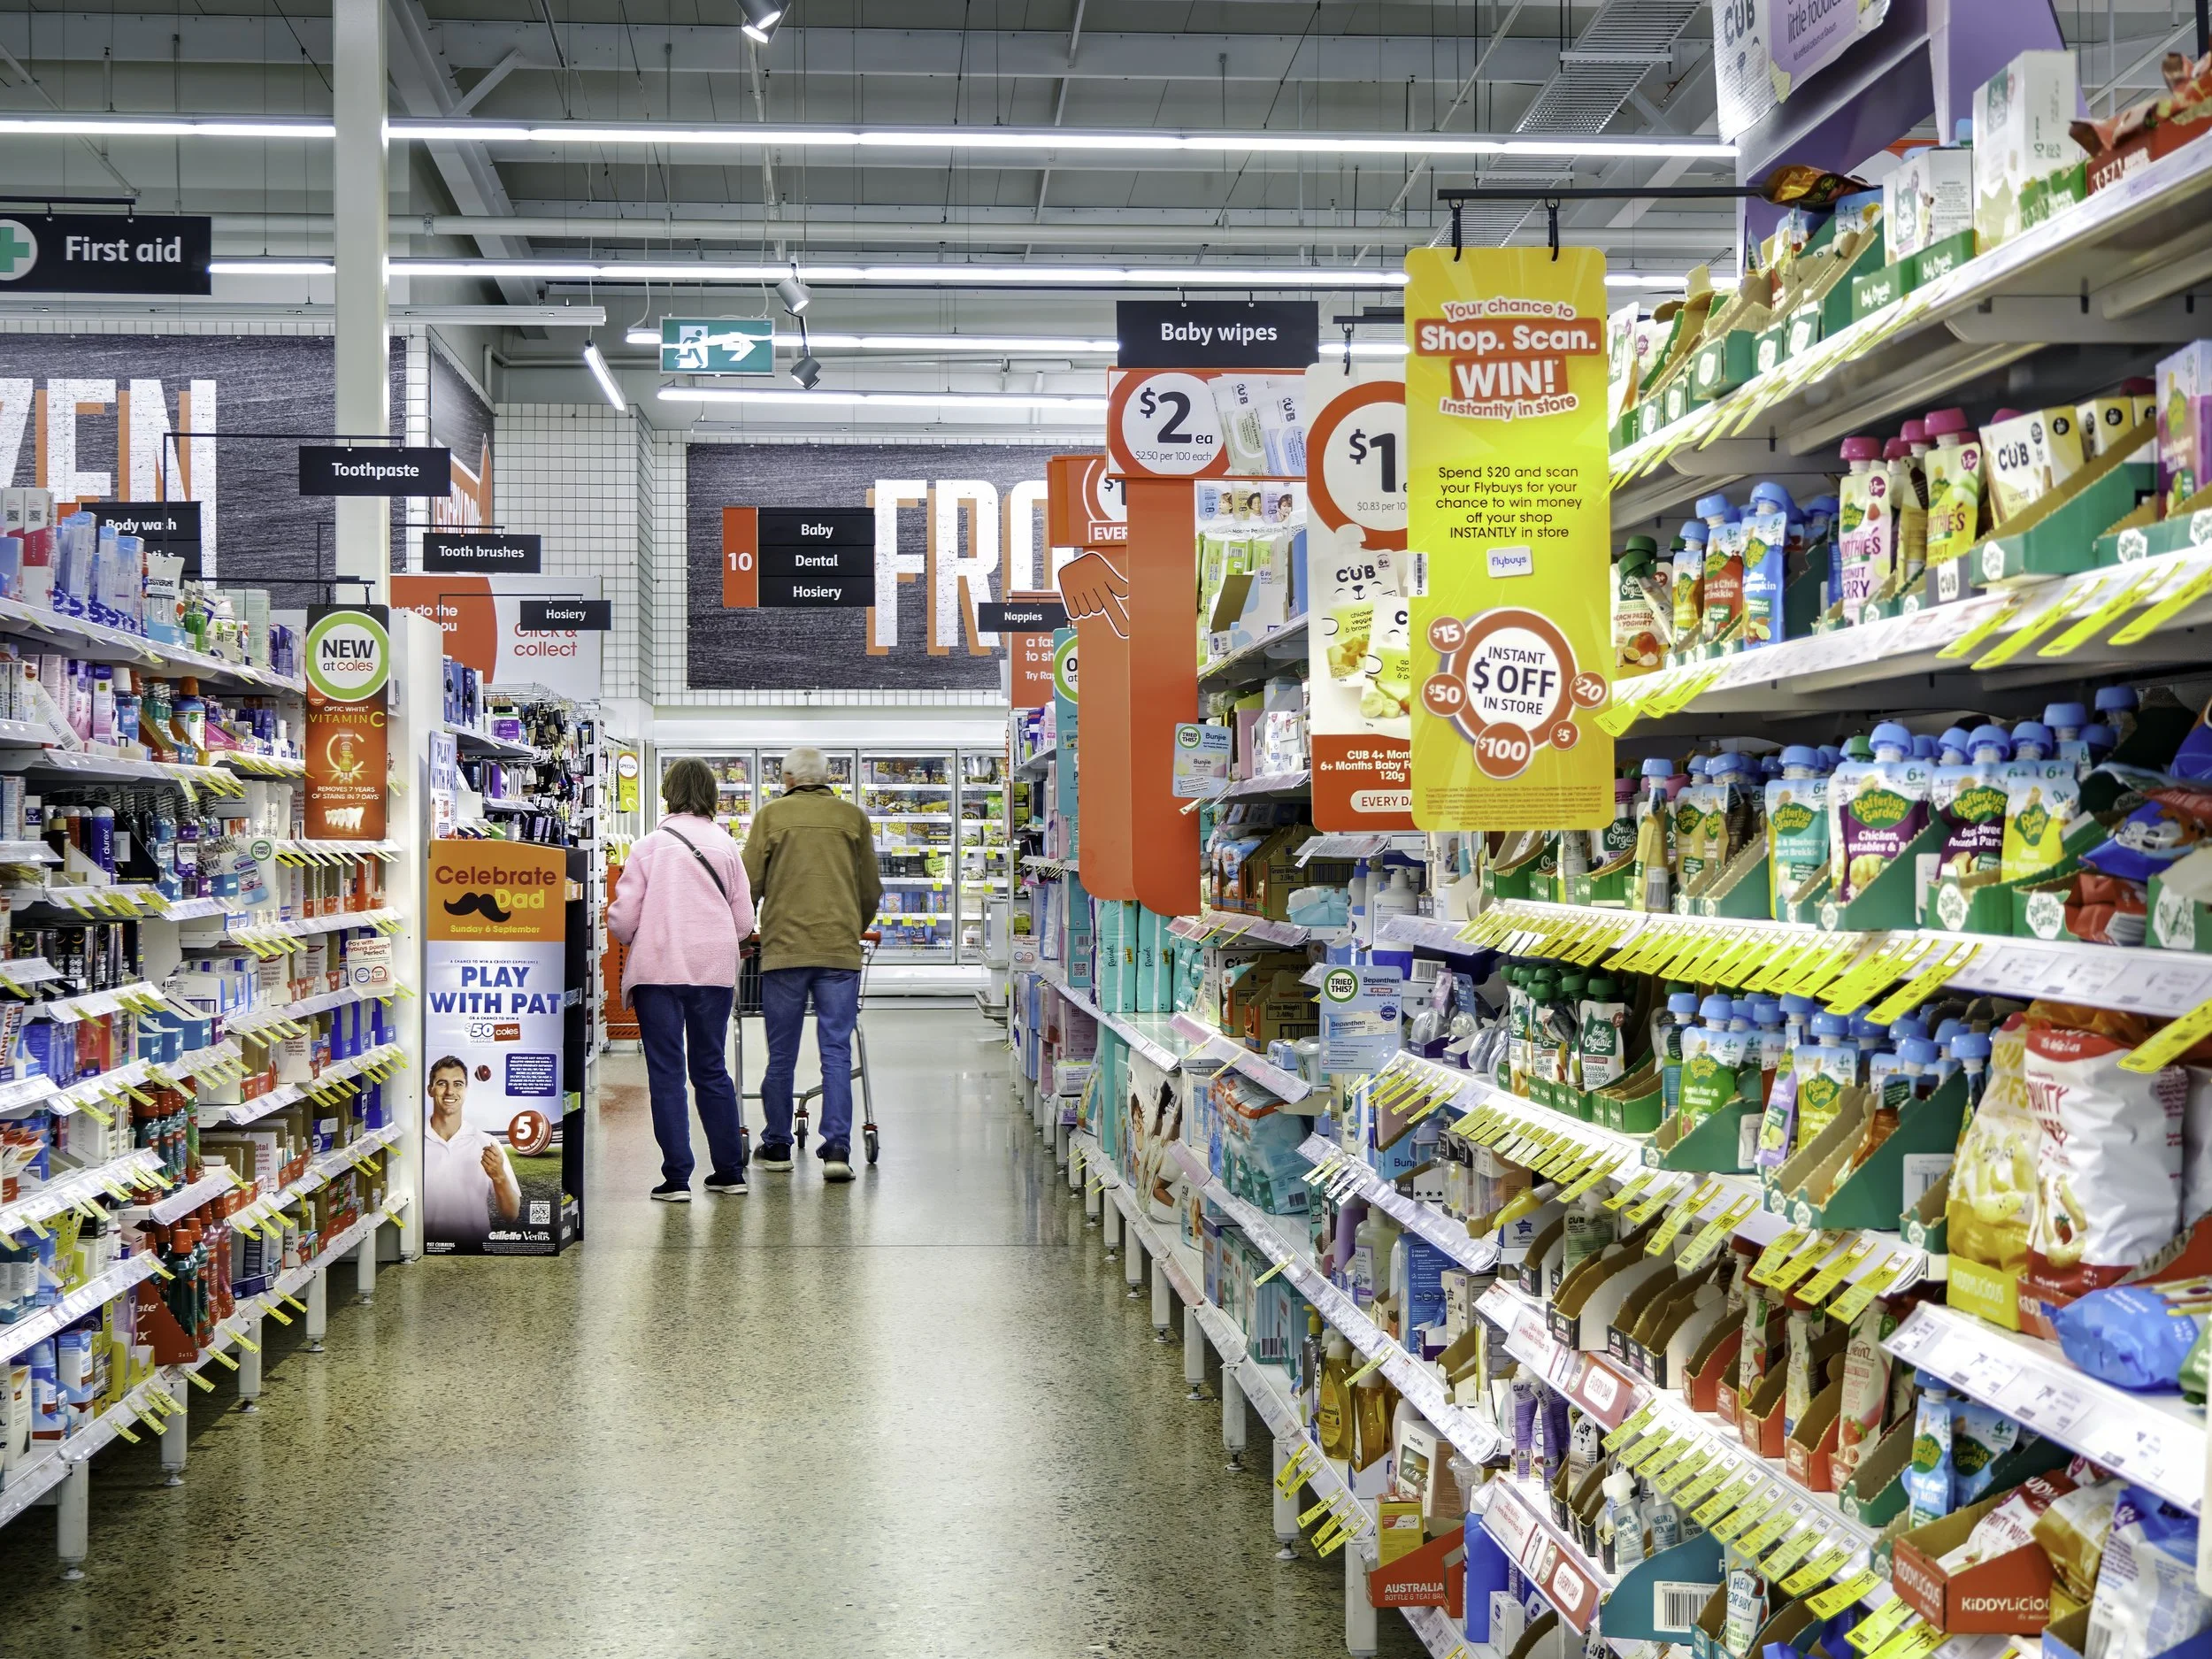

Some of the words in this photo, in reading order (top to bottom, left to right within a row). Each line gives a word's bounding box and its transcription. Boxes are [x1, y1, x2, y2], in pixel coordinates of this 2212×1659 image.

[1788, 9, 1807, 43] little
[65, 235, 129, 262] First
[135, 236, 181, 263] aid
[1444, 300, 1483, 319] Your
[1487, 299, 1554, 314] chance
[1557, 303, 1574, 318] to
[1161, 322, 1213, 346] Baby
[1217, 323, 1278, 346] wipes
[1421, 326, 1505, 355] Shop.
[1512, 325, 1596, 350] Scan.
[1442, 399, 1513, 419] Instantly
[1518, 401, 1532, 417] in
[1536, 396, 1577, 414] store
[1140, 388, 1192, 443] $2
[1195, 434, 1213, 444] ea
[1135, 450, 1158, 461] $2.50
[1159, 453, 1174, 462] per
[1175, 452, 1191, 461] 100
[1192, 452, 1212, 461] each
[332, 462, 419, 480] Toothpaste
[1439, 467, 1482, 479] Spend
[1486, 467, 1510, 478] $20
[1514, 467, 1541, 478] and
[1546, 469, 1578, 478] scan
[1440, 485, 1471, 495] your
[1474, 482, 1523, 495] Flybuys
[1526, 482, 1545, 492] for
[1548, 484, 1577, 495] your
[1357, 502, 1380, 511] $0.83
[1396, 502, 1408, 511] 10
[1436, 497, 1488, 508] chance
[1493, 498, 1505, 508] to
[1509, 497, 1532, 508] win
[1536, 498, 1582, 510] money
[105, 519, 139, 534] Body
[1466, 512, 1483, 523] off
[1486, 514, 1516, 526] your
[1519, 512, 1553, 525] shop
[801, 524, 833, 539] Baby
[1450, 526, 1518, 538] INSTANTLY
[1521, 526, 1532, 538] in
[1537, 527, 1570, 538] store
[439, 545, 473, 557] Tooth
[476, 545, 525, 558] brushes
[727, 552, 753, 572] 10
[795, 554, 839, 567] Dental
[1336, 565, 1376, 583] CUB
[793, 585, 842, 601] Hosiery
[415, 605, 433, 617] do
[436, 604, 458, 617] the
[546, 609, 587, 621] Hosiery
[1004, 611, 1042, 622] Nappies
[1433, 624, 1460, 643] $15
[322, 639, 375, 659] NEW
[514, 642, 578, 657] collect
[1025, 638, 1035, 648] a
[1025, 651, 1039, 662] to
[1488, 646, 1546, 665] INSTANT
[323, 662, 335, 671] at
[337, 660, 373, 672] coles
[1025, 672, 1037, 681] Try
[1472, 657, 1490, 694] $
[1497, 664, 1556, 698] OFF
[1427, 684, 1461, 704] $50
[1575, 676, 1602, 702] $20
[1484, 695, 1498, 709] IN
[1501, 698, 1543, 716] STORE
[310, 714, 368, 724] VITAMIN
[370, 710, 386, 728] C
[1205, 732, 1227, 742] Bunjie
[1556, 728, 1571, 742] $5
[1347, 750, 1370, 760] CUB
[1371, 750, 1385, 760] 4+
[1479, 737, 1527, 761] $100
[1320, 761, 1333, 771] 6+
[1335, 760, 1373, 771] Months
[1374, 760, 1402, 772] Baby
[1379, 771, 1406, 782] 120g
[1907, 768, 1926, 781] 6+
[1361, 796, 1398, 807] EVERY
[1854, 795, 1907, 818] Rafferty's
[1863, 807, 1902, 824] Garden
[1858, 831, 1900, 842] Chicken,
[434, 865, 557, 886] Celebrate
[494, 888, 545, 909] Dad
[449, 925, 483, 933] Sunday
[493, 925, 540, 933] September
[461, 966, 530, 987] PLAY
[429, 993, 502, 1014] WITH
[511, 994, 561, 1014] PAT
[465, 1023, 495, 1038] $50
[495, 1028, 519, 1037] coles
[516, 1116, 532, 1140] 5
[488, 1231, 522, 1240] Gillette
[1385, 1583, 1443, 1593] AUSTRALIA
[1733, 1578, 1753, 1594] HEINZ
